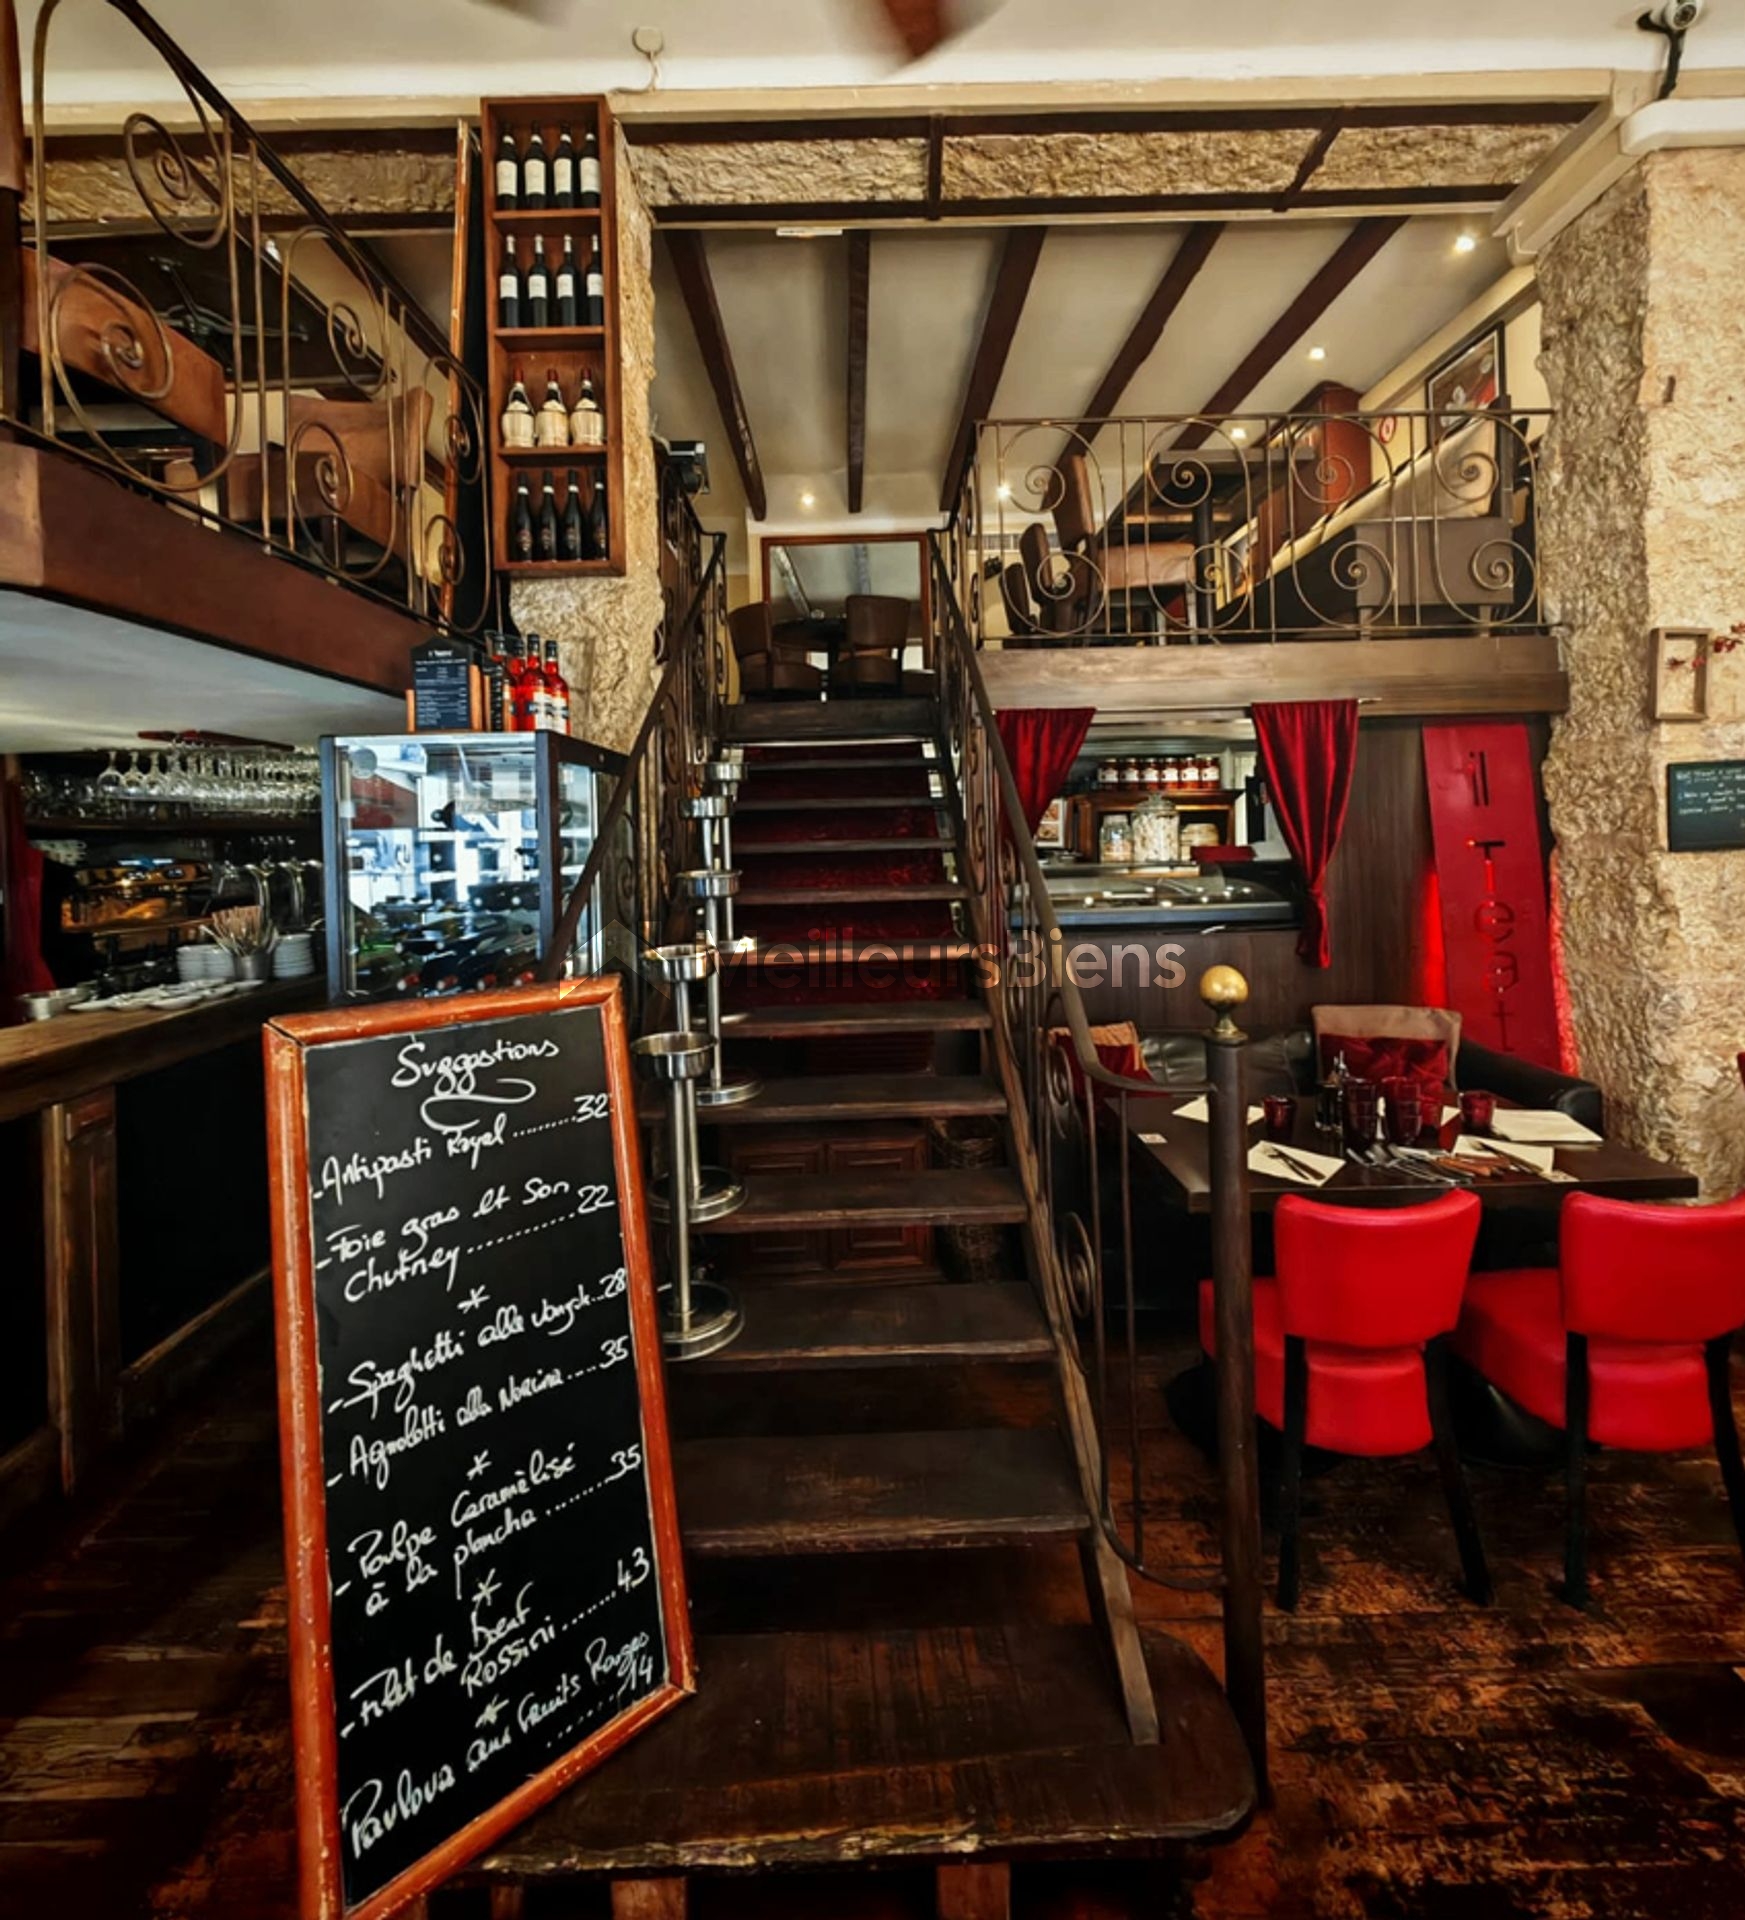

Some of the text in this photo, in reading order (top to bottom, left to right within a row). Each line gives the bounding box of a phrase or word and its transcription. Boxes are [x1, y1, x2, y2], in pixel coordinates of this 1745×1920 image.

[391, 1039, 559, 1098] Suggestions
[574, 1094, 610, 1123] 32
[577, 1184, 615, 1216] 22
[401, 1207, 461, 1261] gras
[343, 1329, 466, 1419] Spaghetti
[599, 1267, 627, 1298] 28
[599, 1335, 629, 1369] 35
[405, 1555, 438, 1593] la
[453, 1506, 538, 1600] plancha
[604, 1443, 642, 1483] 35
[617, 1546, 650, 1593] 43
[423, 1633, 458, 1685] de
[342, 1763, 456, 1859] Pavlova
